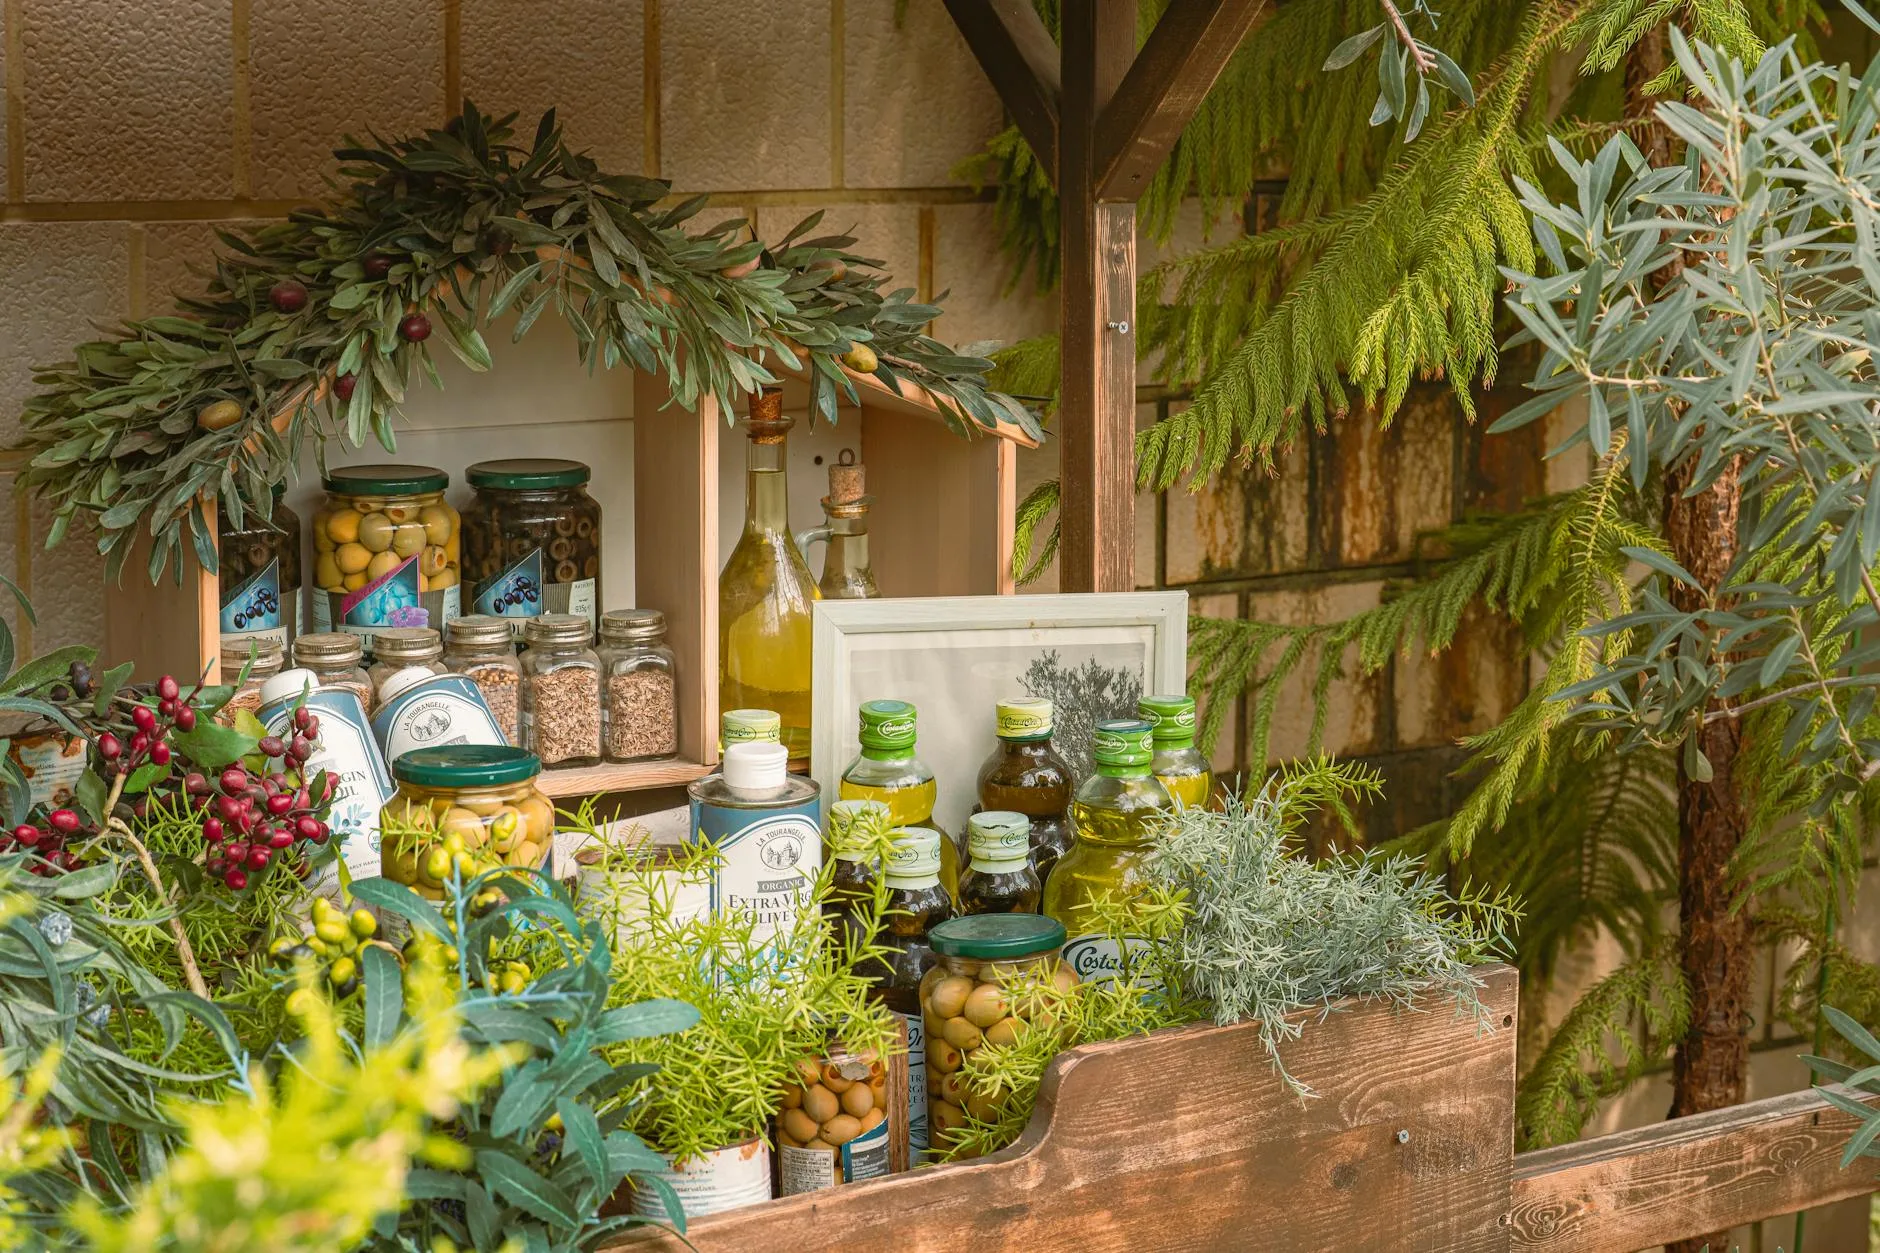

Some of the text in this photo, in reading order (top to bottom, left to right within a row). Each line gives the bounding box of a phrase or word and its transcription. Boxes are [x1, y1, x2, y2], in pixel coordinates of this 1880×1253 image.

[404, 702, 450, 731] LA TOURANGELLE
[756, 828, 806, 847] LA TOURANGELLE
[729, 894, 780, 909] EXTRA
